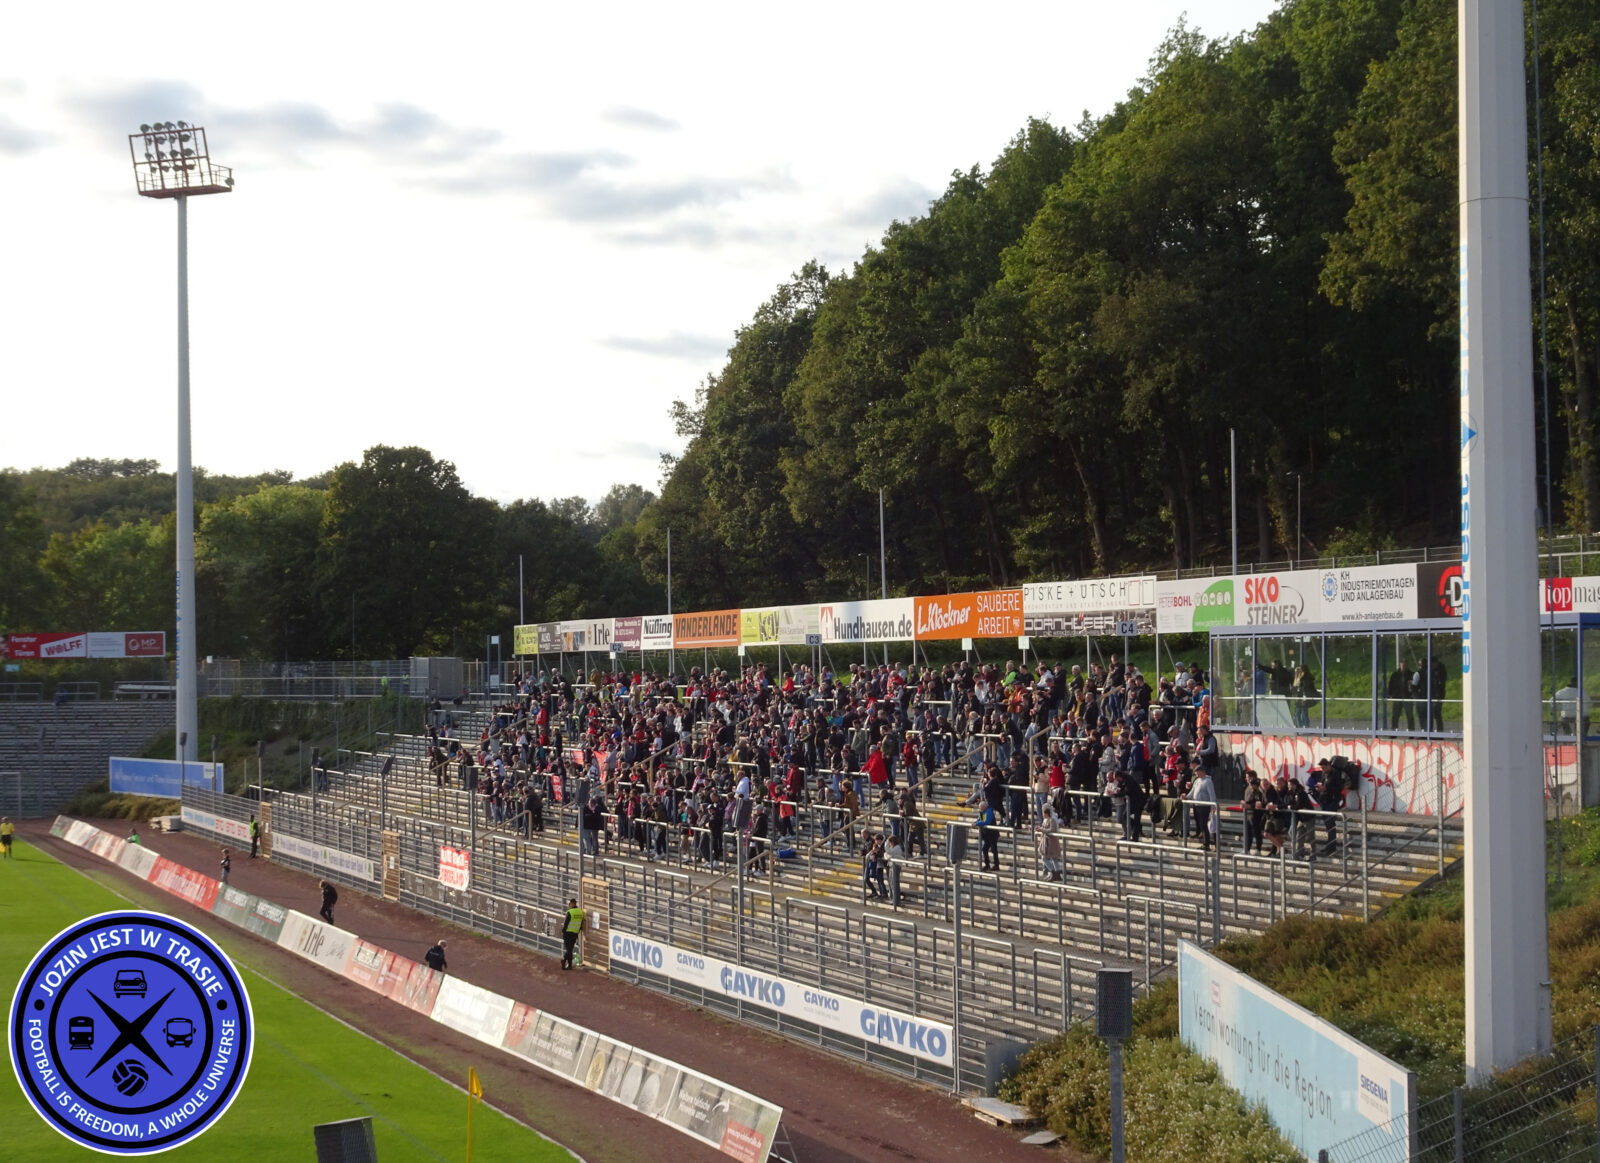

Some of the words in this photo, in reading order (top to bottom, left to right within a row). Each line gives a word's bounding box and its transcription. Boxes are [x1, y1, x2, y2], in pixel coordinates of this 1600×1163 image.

[1341, 571, 1350, 581] KH
[1341, 578, 1415, 591] INDUSTRIEMONTAGEN
[1024, 585, 1062, 601] PISKE
[1080, 582, 1127, 599] UTSCH
[1245, 576, 1279, 605] SKO
[1341, 592, 1356, 602] UND
[1356, 590, 1404, 601] ANLAGENBAU
[977, 592, 1020, 613] SAUBERE
[917, 600, 971, 634] L.Klöckner
[977, 615, 1013, 635] ARBEIT.
[1247, 605, 1297, 625] STEINER
[593, 624, 610, 645] Irle
[675, 614, 738, 638] VANDERLANDE
[834, 613, 912, 640] Hundhausen.de
[1121, 622, 1134, 634] C4
[809, 635, 820, 645] C3
[302, 923, 325, 957] Irle
[612, 935, 663, 969] GAYKO
[676, 952, 705, 971] GAYKO
[720, 966, 785, 1008] GAYKO
[804, 990, 840, 1012] GAYKO
[860, 1009, 947, 1058] GAYKO
[1257, 1031, 1270, 1074] für
[1274, 1045, 1290, 1090] die
[1294, 1058, 1337, 1125] Region.
[1360, 1074, 1389, 1105] SIEGENIA
